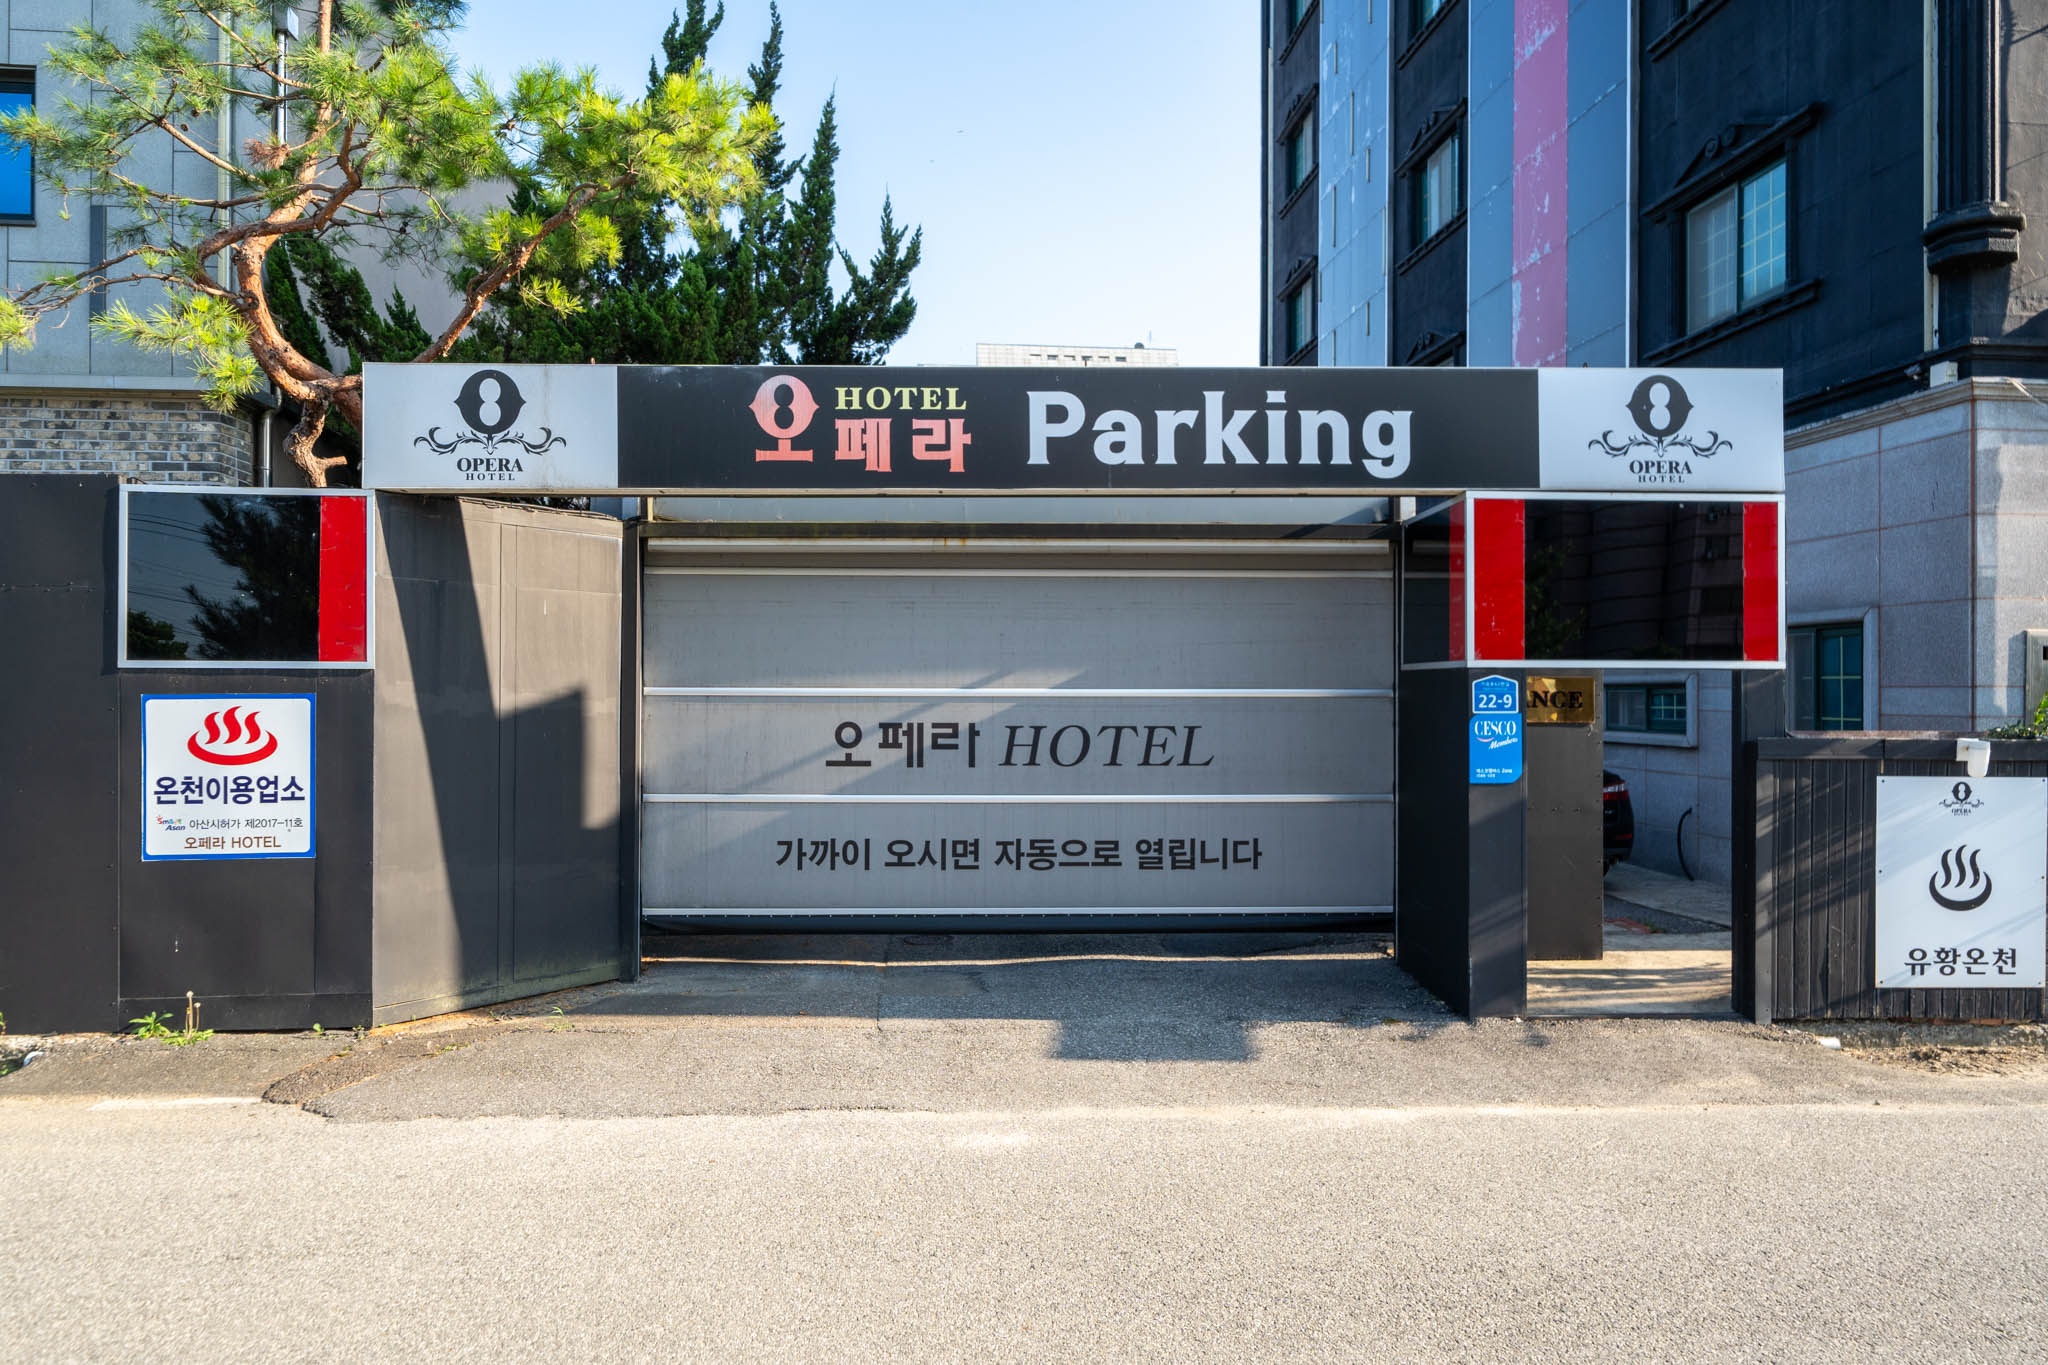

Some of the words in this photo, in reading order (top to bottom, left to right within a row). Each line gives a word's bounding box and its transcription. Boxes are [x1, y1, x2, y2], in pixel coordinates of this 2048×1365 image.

[835, 387, 967, 411] HOTEL
[1027, 390, 1414, 479] Parking
[457, 457, 524, 473] OPERA
[1628, 460, 1693, 475] OPERA
[465, 473, 516, 481] HOTEL
[1637, 475, 1686, 483] HOTEL
[1478, 694, 1512, 708] 22-9
[1527, 690, 1584, 709] NCE
[1474, 720, 1517, 736] CESCO
[825, 721, 981, 768] 오페라
[998, 724, 1216, 767] HOTEL
[153, 775, 306, 805] 온천이용업소
[189, 818, 241, 830] 아산시허가
[184, 836, 226, 850] 오페라
[231, 836, 282, 848] HOTEL
[775, 838, 871, 871] 가까이
[884, 838, 981, 871] 오시면
[994, 838, 1123, 871] 자동으로
[1135, 838, 1263, 871] 열립니다
[1904, 947, 2017, 976] 유황온천
